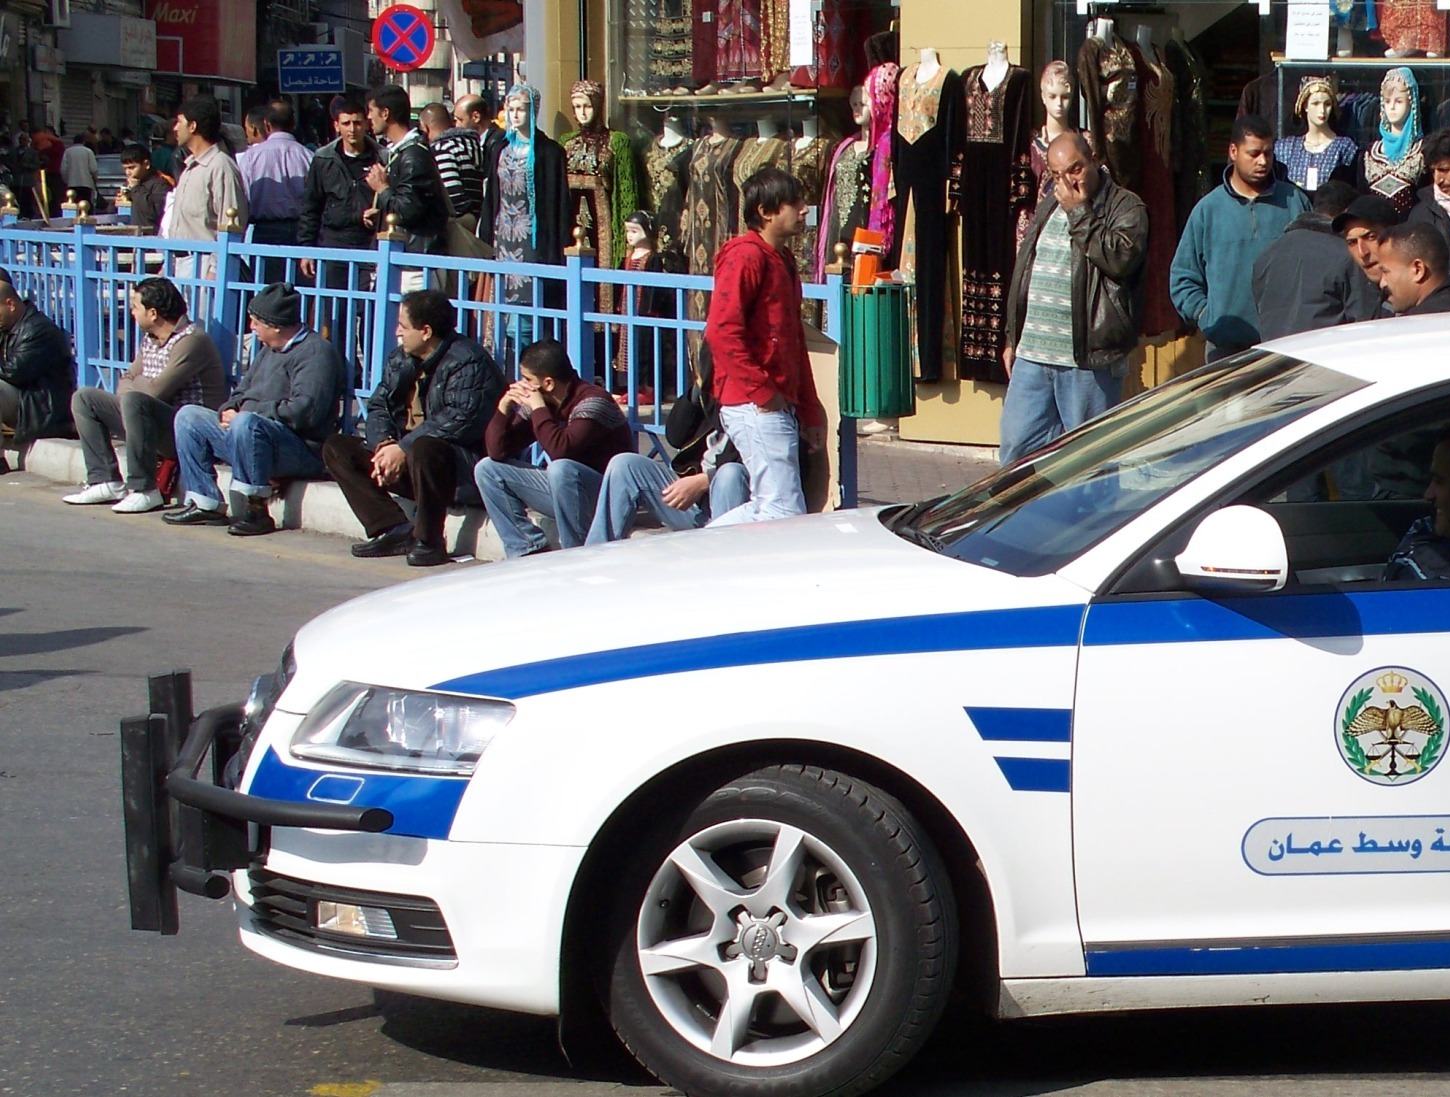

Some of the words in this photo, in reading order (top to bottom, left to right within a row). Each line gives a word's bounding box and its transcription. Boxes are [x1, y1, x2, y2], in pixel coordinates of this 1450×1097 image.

[152, 2, 199, 24] Maxi
[283, 75, 313, 88] فيصل
[1268, 832, 1344, 861] عمان
[1352, 830, 1423, 859] وسط
